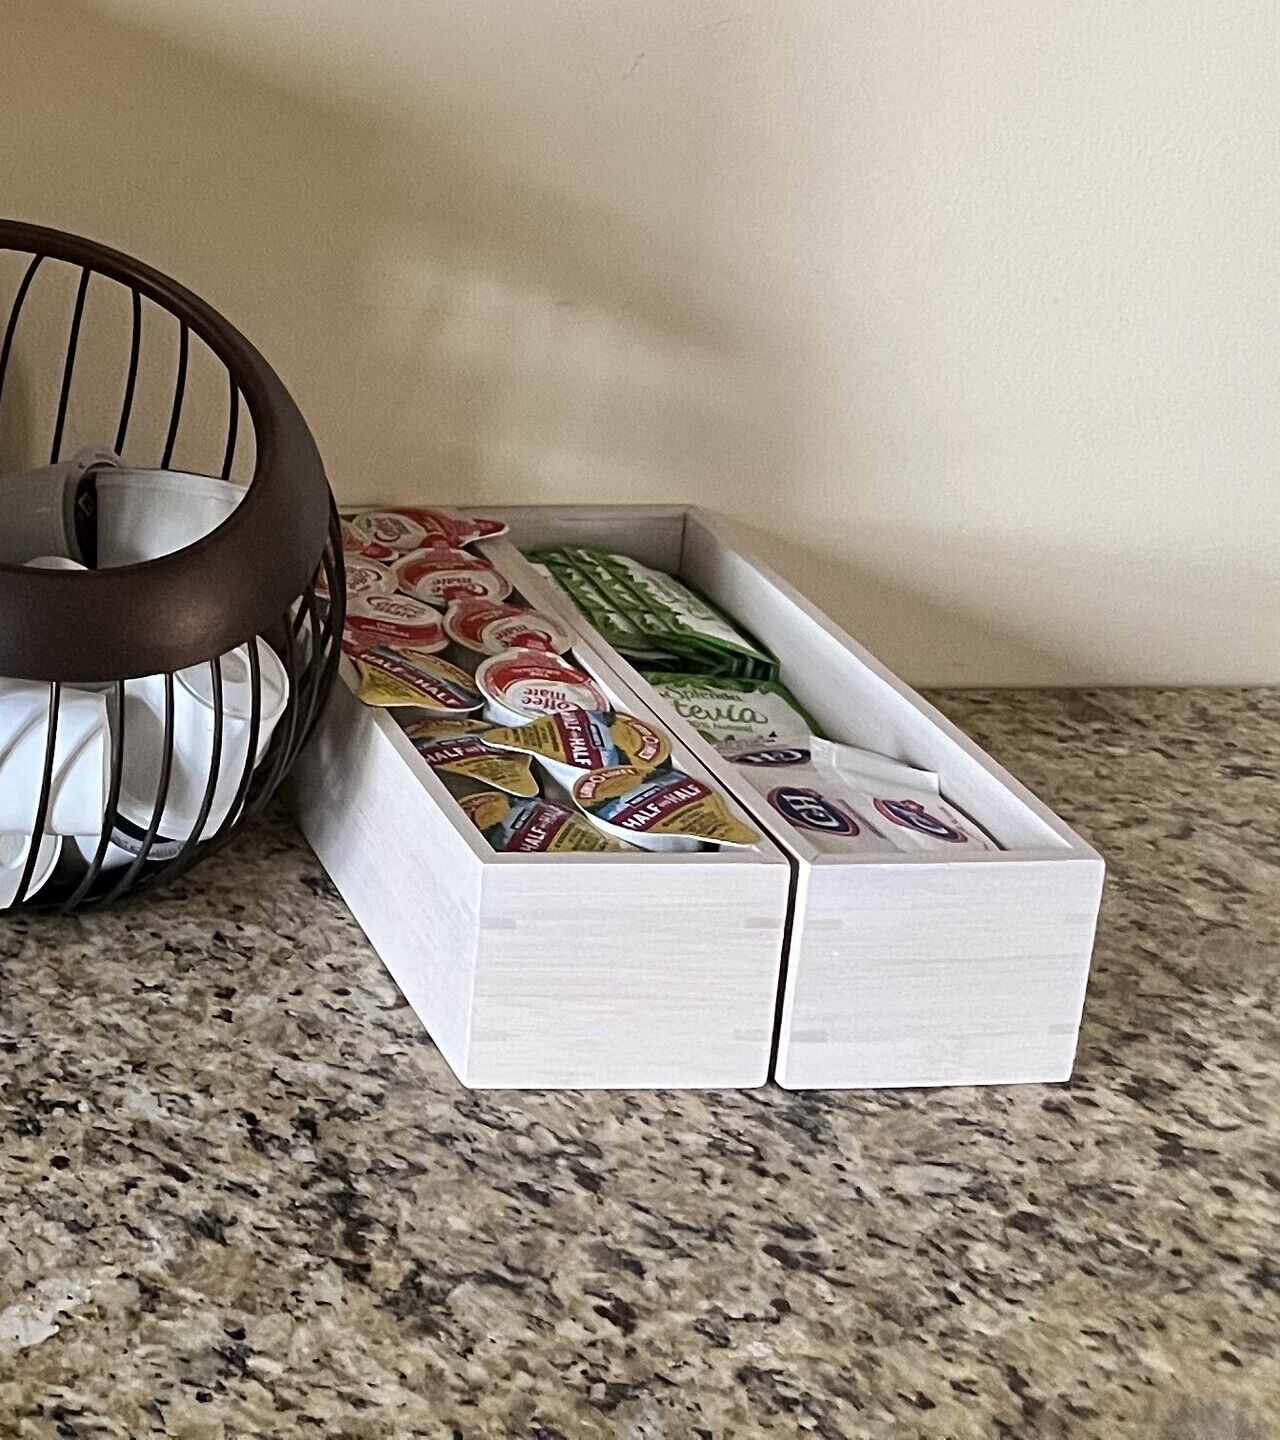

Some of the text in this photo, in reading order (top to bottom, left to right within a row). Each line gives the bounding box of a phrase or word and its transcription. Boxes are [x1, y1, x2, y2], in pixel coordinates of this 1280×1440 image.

[414, 678, 461, 706] HALF
[522, 687, 566, 700] mate
[674, 700, 768, 725] tevia
[569, 737, 593, 767] HALF
[622, 802, 663, 830] HALF
[666, 784, 702, 806] HALF
[519, 825, 547, 852] HALF
